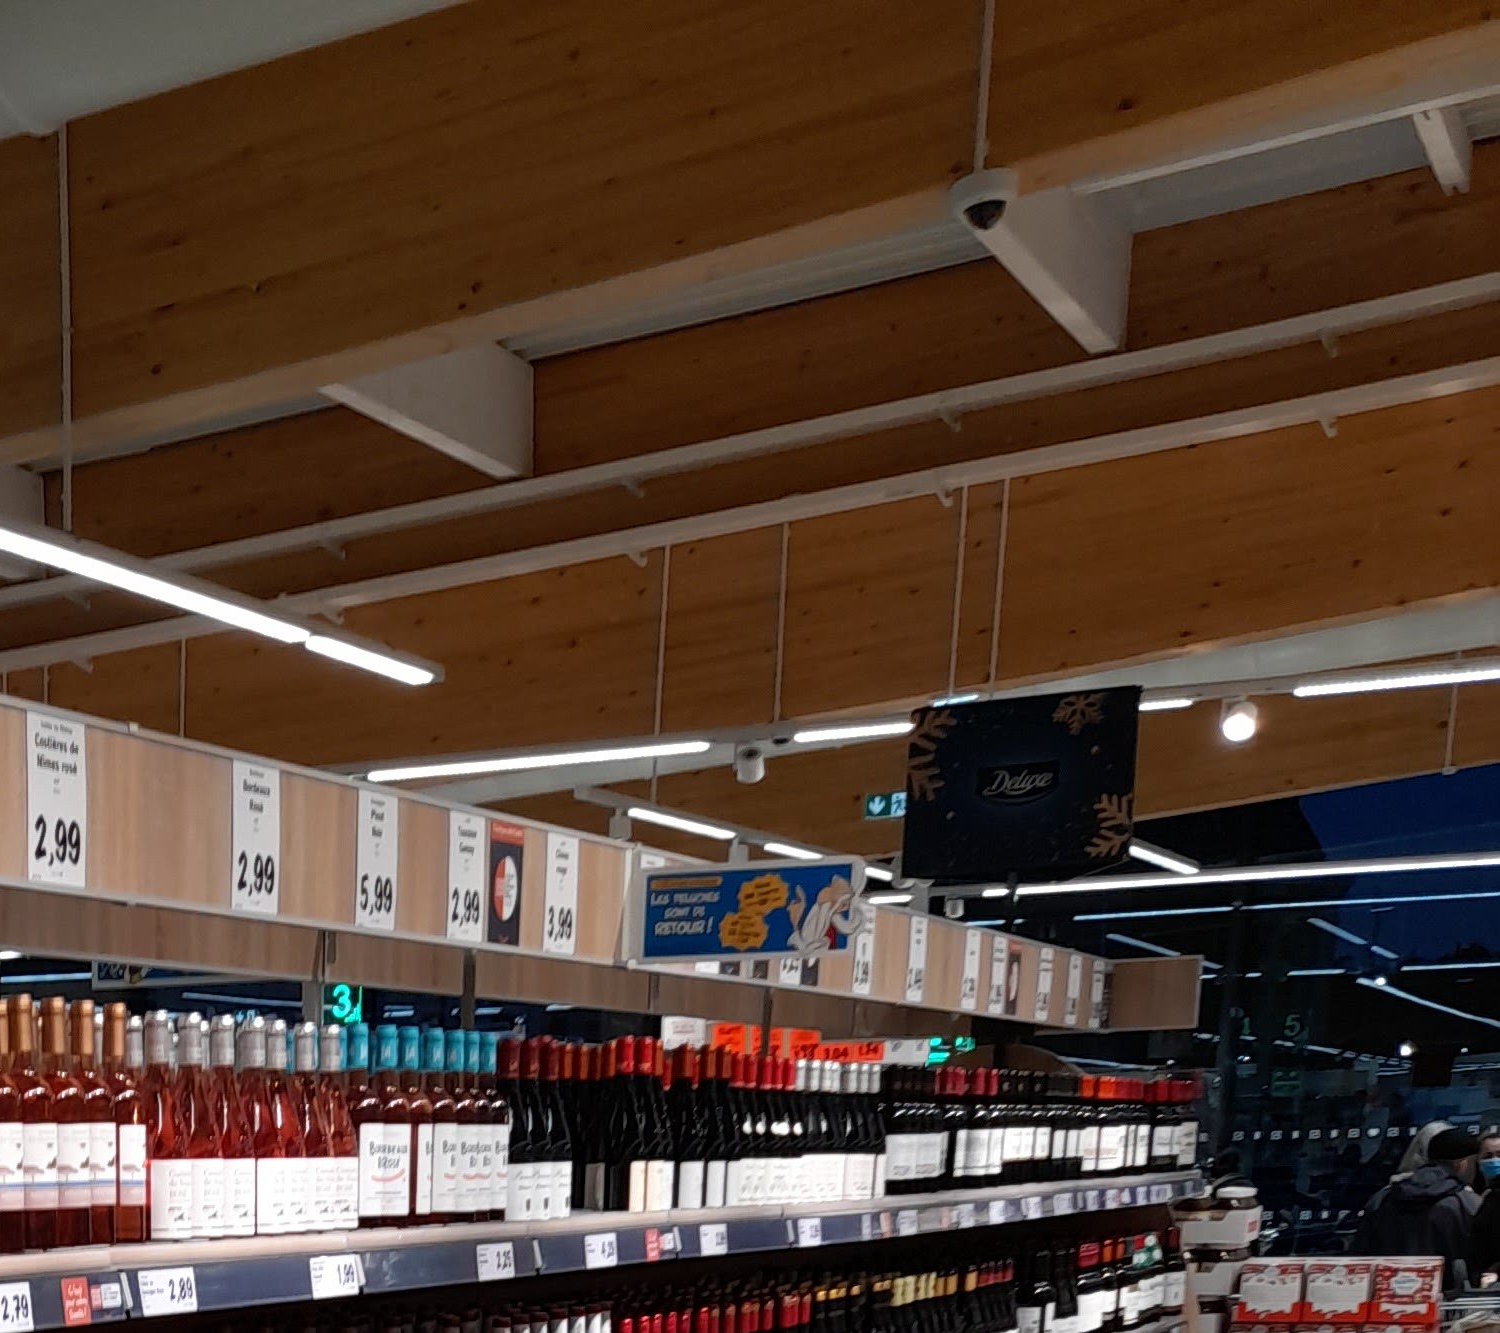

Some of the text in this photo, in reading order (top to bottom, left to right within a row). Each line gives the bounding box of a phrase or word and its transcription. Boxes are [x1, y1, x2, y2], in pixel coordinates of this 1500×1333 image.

[981, 768, 1054, 797] Deluxe
[34, 812, 81, 868] 2,99
[236, 849, 276, 897] 2,99
[359, 872, 393, 917] 5,99
[0, 1293, 29, 1323] 2,79
